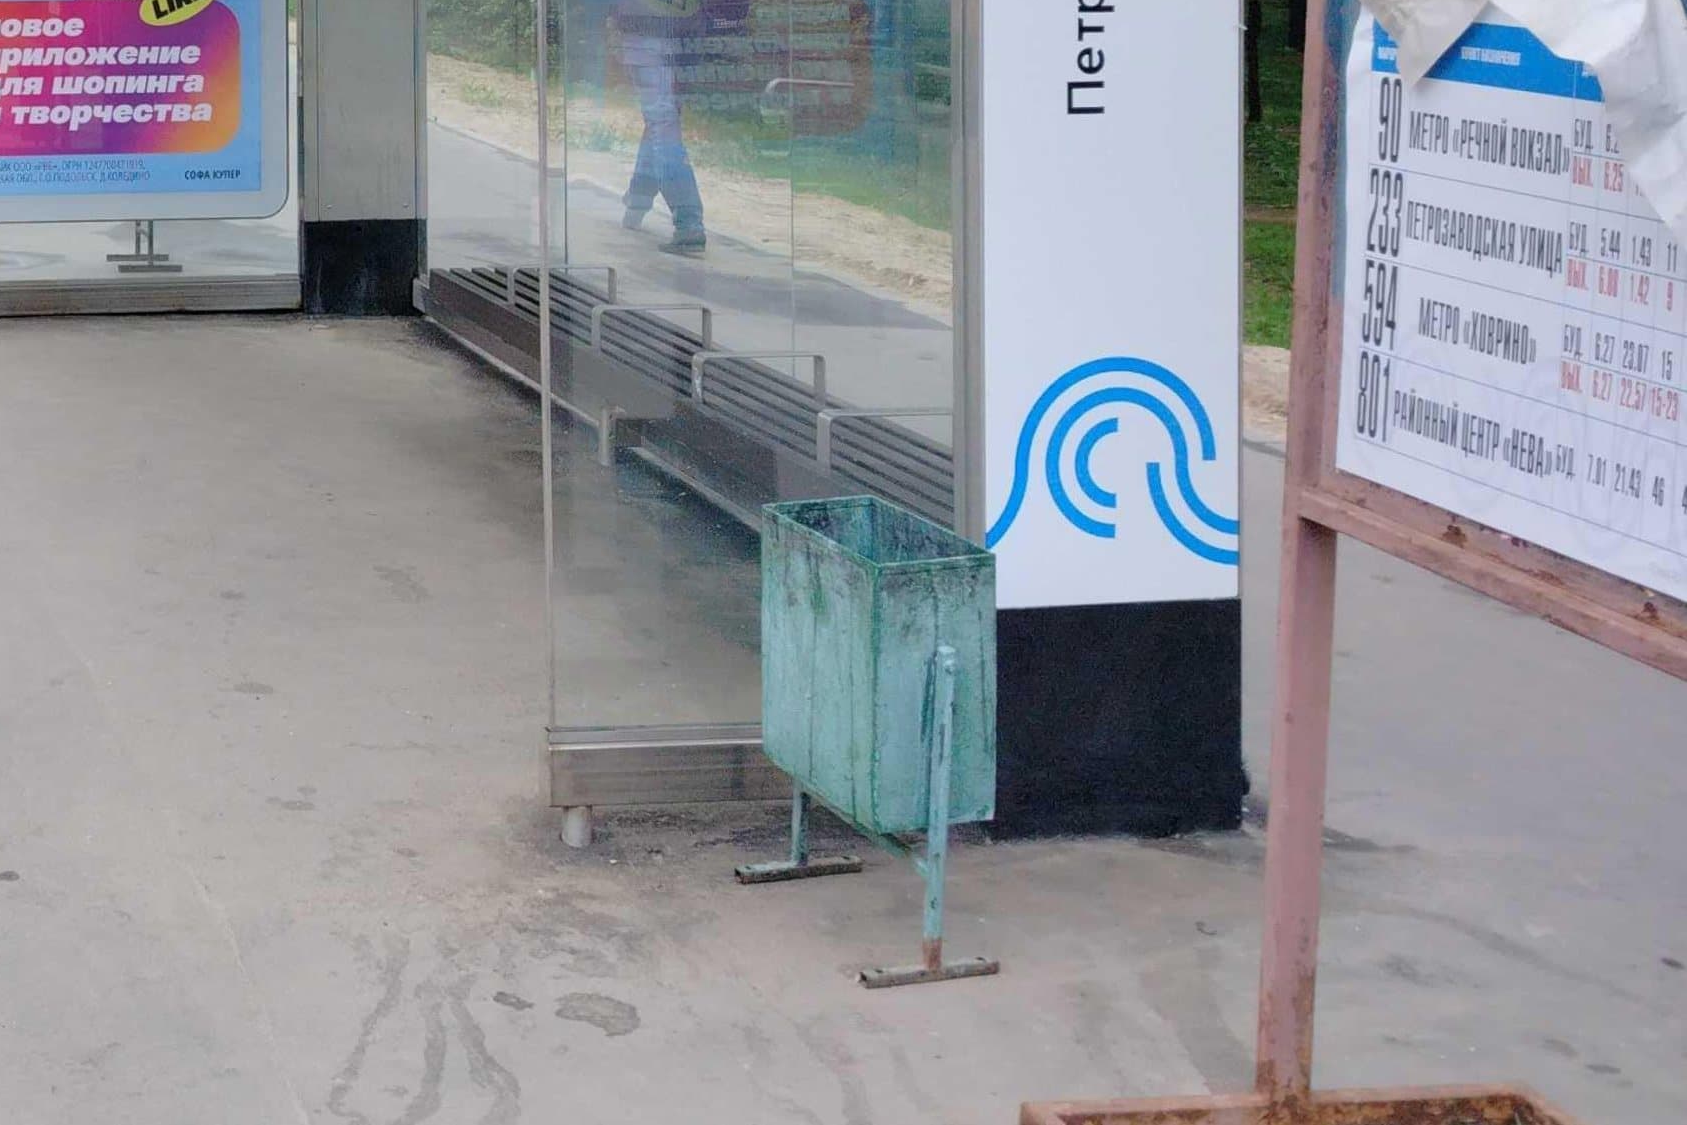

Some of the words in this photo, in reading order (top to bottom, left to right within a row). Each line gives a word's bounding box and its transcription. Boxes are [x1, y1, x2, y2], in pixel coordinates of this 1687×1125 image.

[10, 102, 213, 132] творчества
[51, 74, 206, 95] шопинга
[1378, 76, 1403, 164] 90
[1409, 110, 1450, 155] МЕТРО
[1453, 117, 1508, 165] «РЕЧНОЙ
[1510, 127, 1571, 176] ВОКЗАЛ»
[184, 170, 211, 181] СОФА
[212, 169, 241, 180] КУПЕР
[1366, 167, 1404, 259] 233
[1406, 200, 1516, 262] ПЕТРОЗАВОДСКАЯ
[1518, 223, 1563, 278] УЛИЦА
[1600, 227, 1621, 261] 5.44
[1631, 234, 1652, 267] 1.43
[1667, 240, 1678, 273] 11
[1361, 259, 1400, 351] 594
[1418, 296, 1460, 345] МЕТРО
[1463, 310, 1537, 365] «ХОВРИНО»
[1594, 332, 1616, 364] 6.27
[1662, 350, 1673, 381] 15
[1356, 350, 1392, 444] 801
[1619, 377, 1647, 411] 22.57
[1393, 387, 1460, 449] РАЙОННЫЙ
[1460, 411, 1501, 462] ЦЕНТР
[1502, 427, 1553, 479] «НЕВА»
[1587, 453, 1607, 488] 7.01
[1613, 462, 1642, 500] 21.43
[1651, 474, 1666, 507] 46
